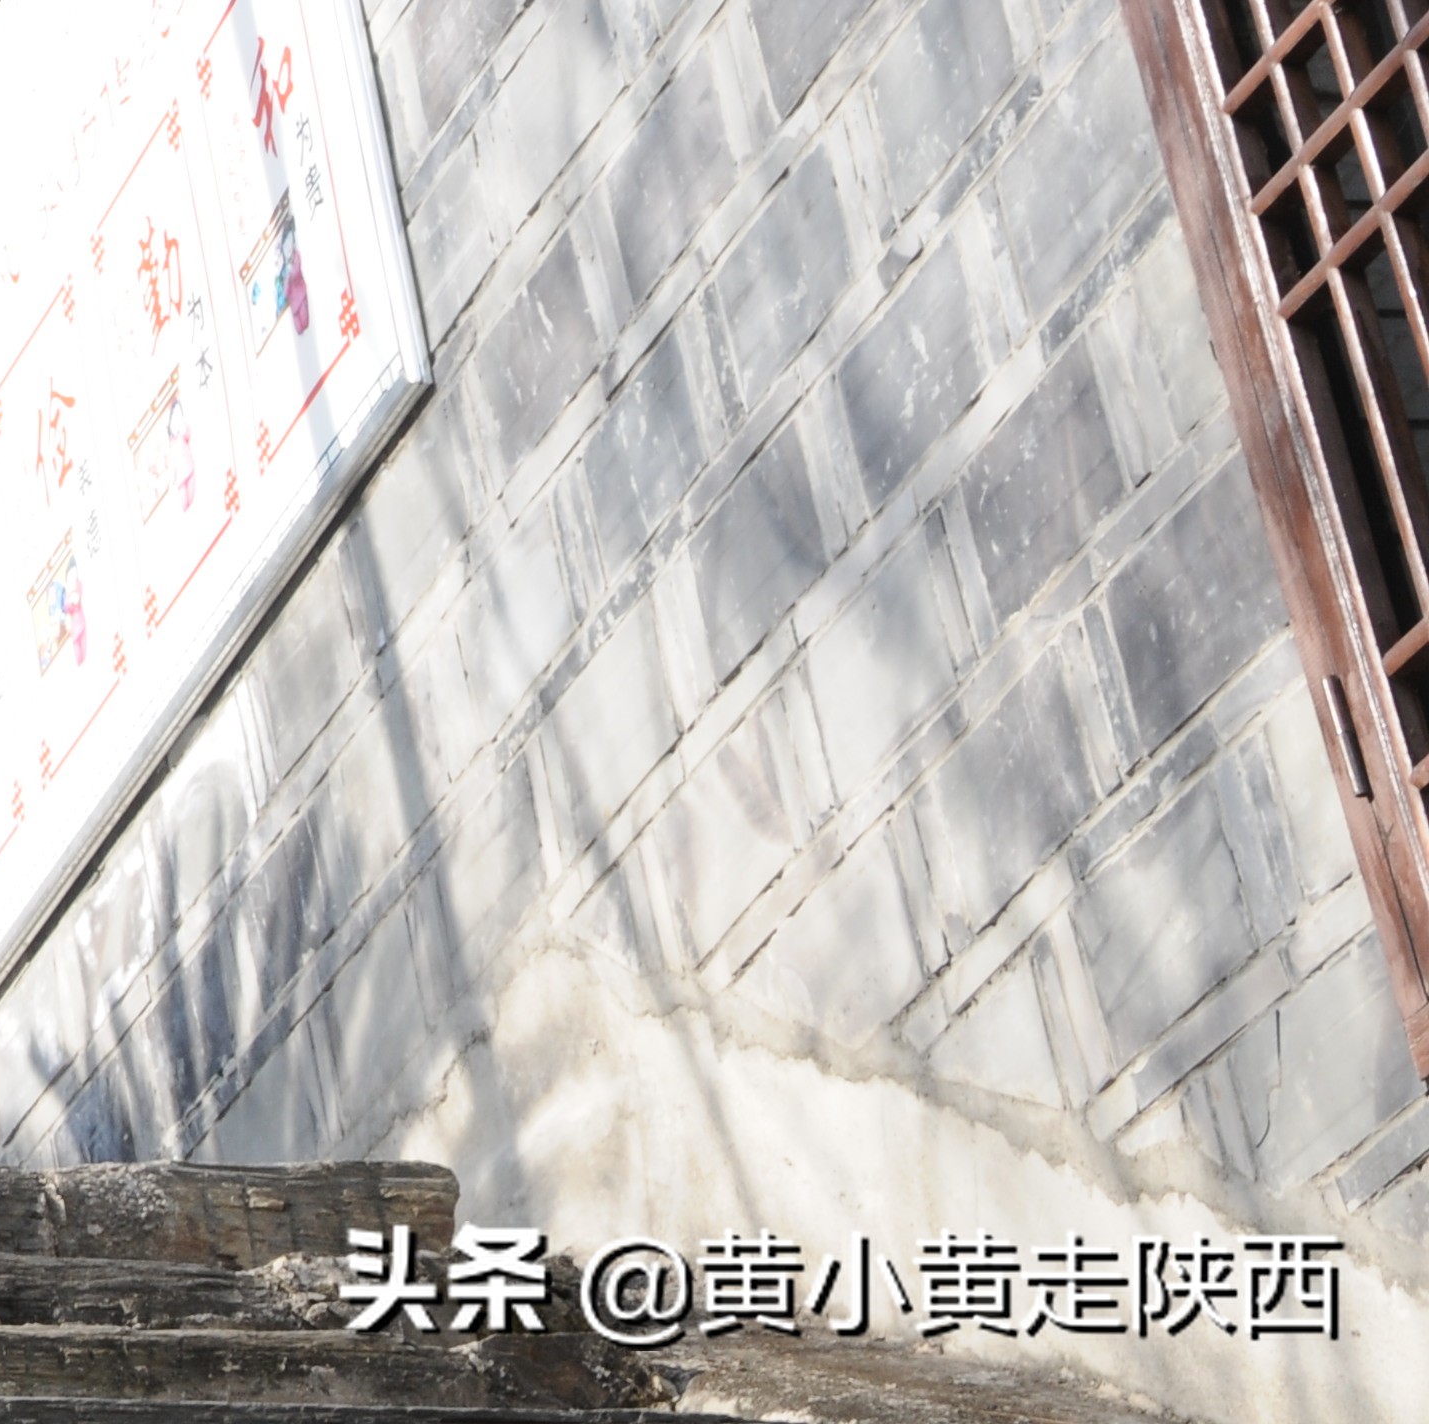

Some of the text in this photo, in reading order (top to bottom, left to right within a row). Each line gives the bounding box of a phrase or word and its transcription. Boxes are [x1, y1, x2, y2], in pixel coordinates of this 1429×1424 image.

[251, 38, 293, 156] 和
[295, 112, 324, 219] 为贵
[136, 216, 182, 352] 勤
[184, 291, 213, 388] 为本
[34, 378, 75, 506] 俭
